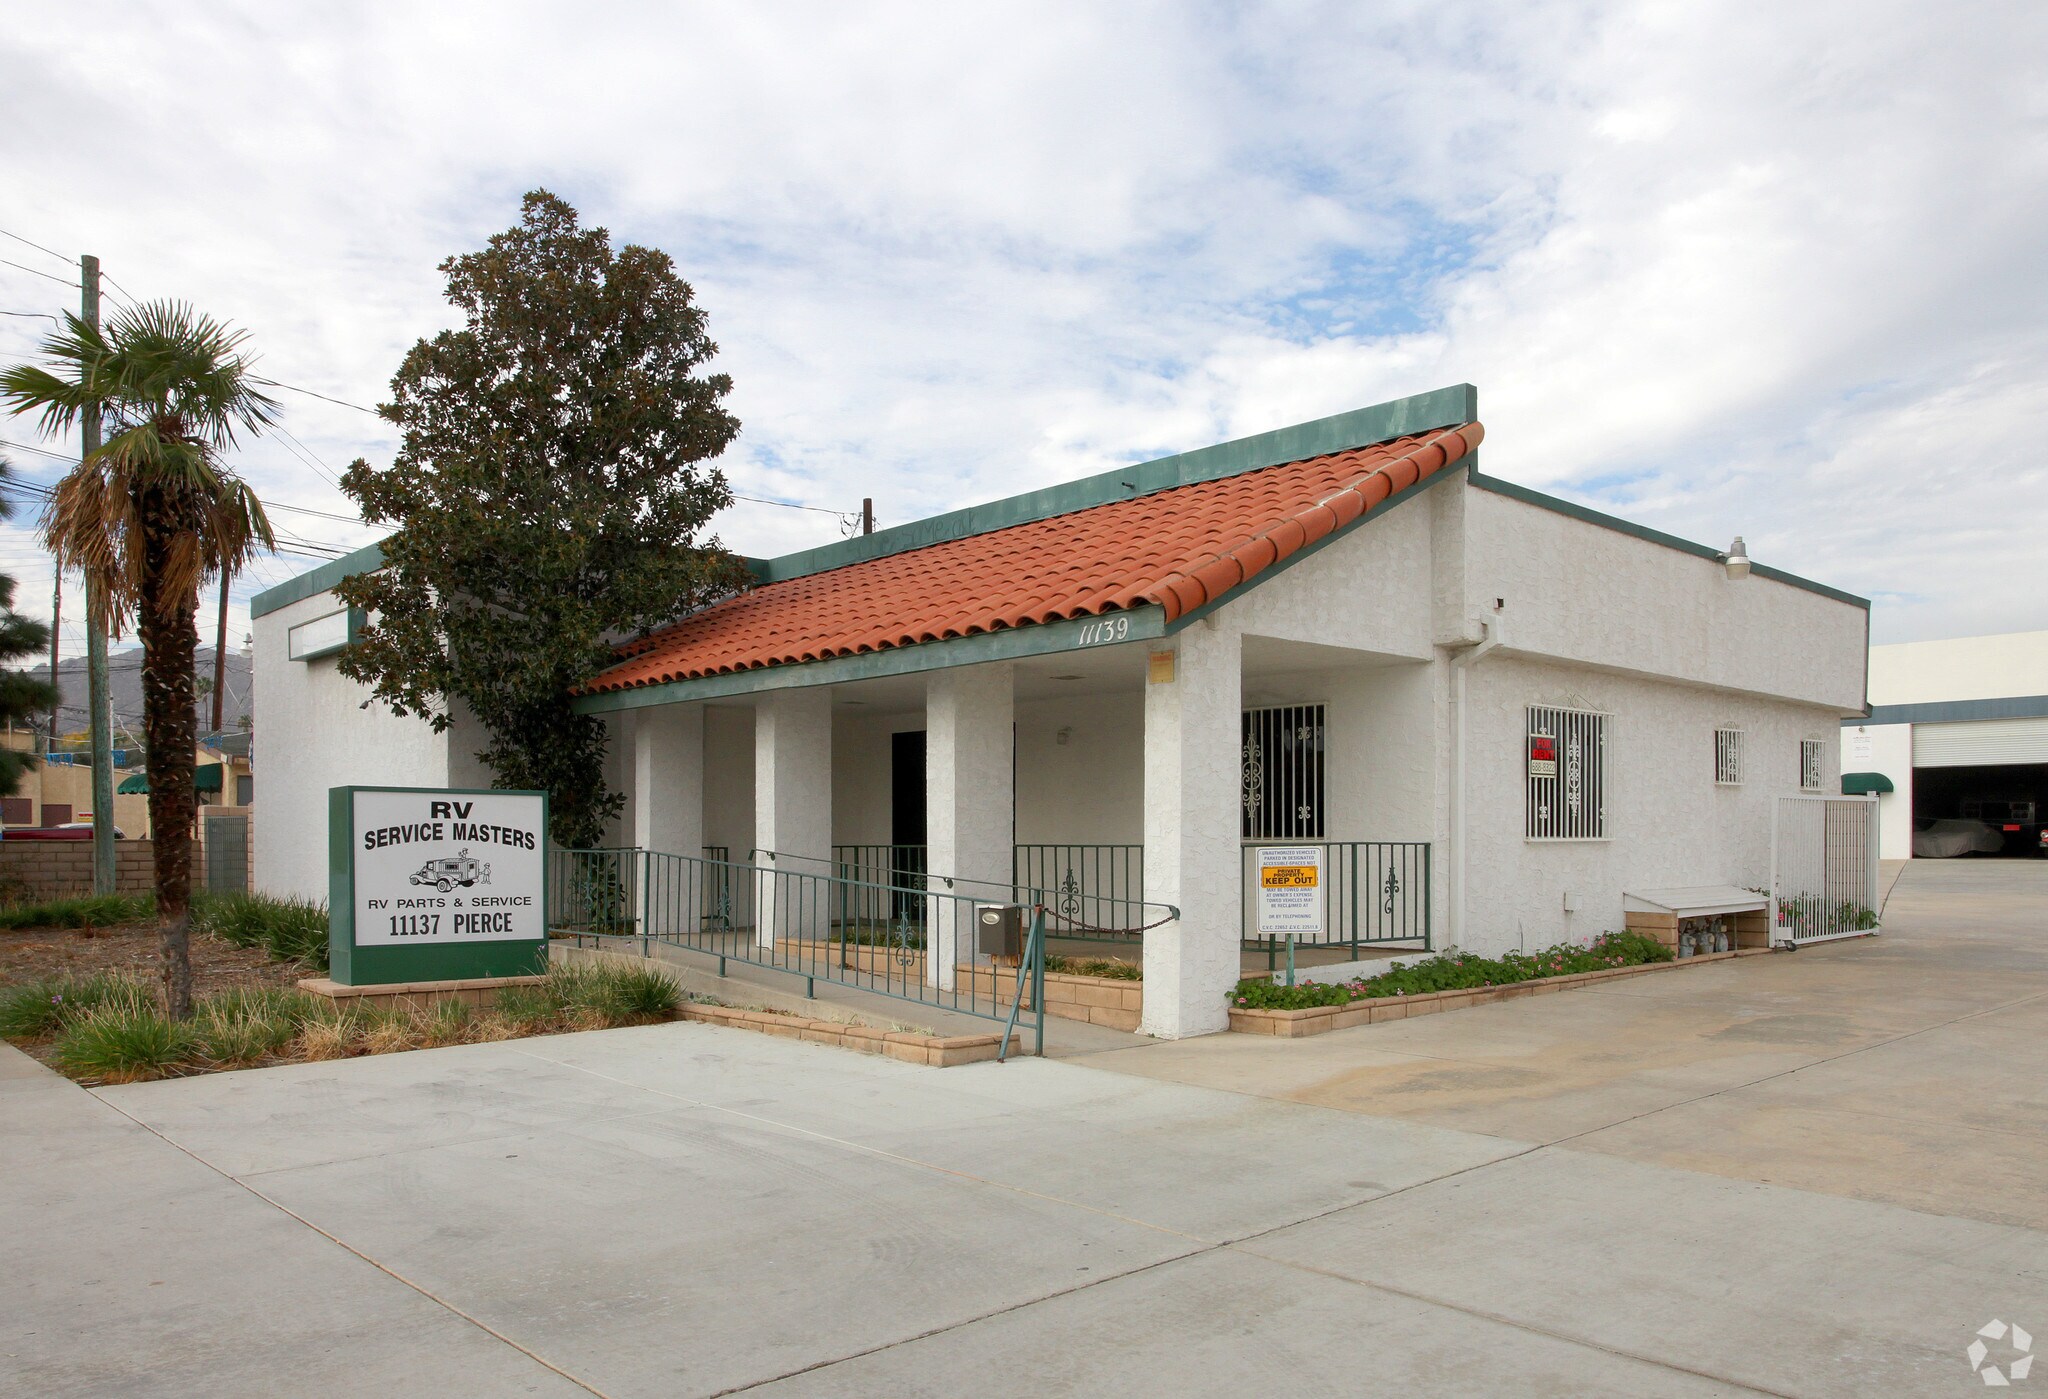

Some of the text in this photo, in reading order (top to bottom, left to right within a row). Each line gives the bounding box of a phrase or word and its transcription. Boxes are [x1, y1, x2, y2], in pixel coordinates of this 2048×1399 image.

[1079, 617, 1128, 645] 11139
[1536, 738, 1551, 749] FOR
[1532, 749, 1555, 760] RENT
[431, 801, 473, 819] RV
[364, 822, 535, 850] SERVICE MASTERS
[368, 896, 532, 909] RV PARTS & SERVICE
[389, 912, 513, 936] 11137 PIERCE
